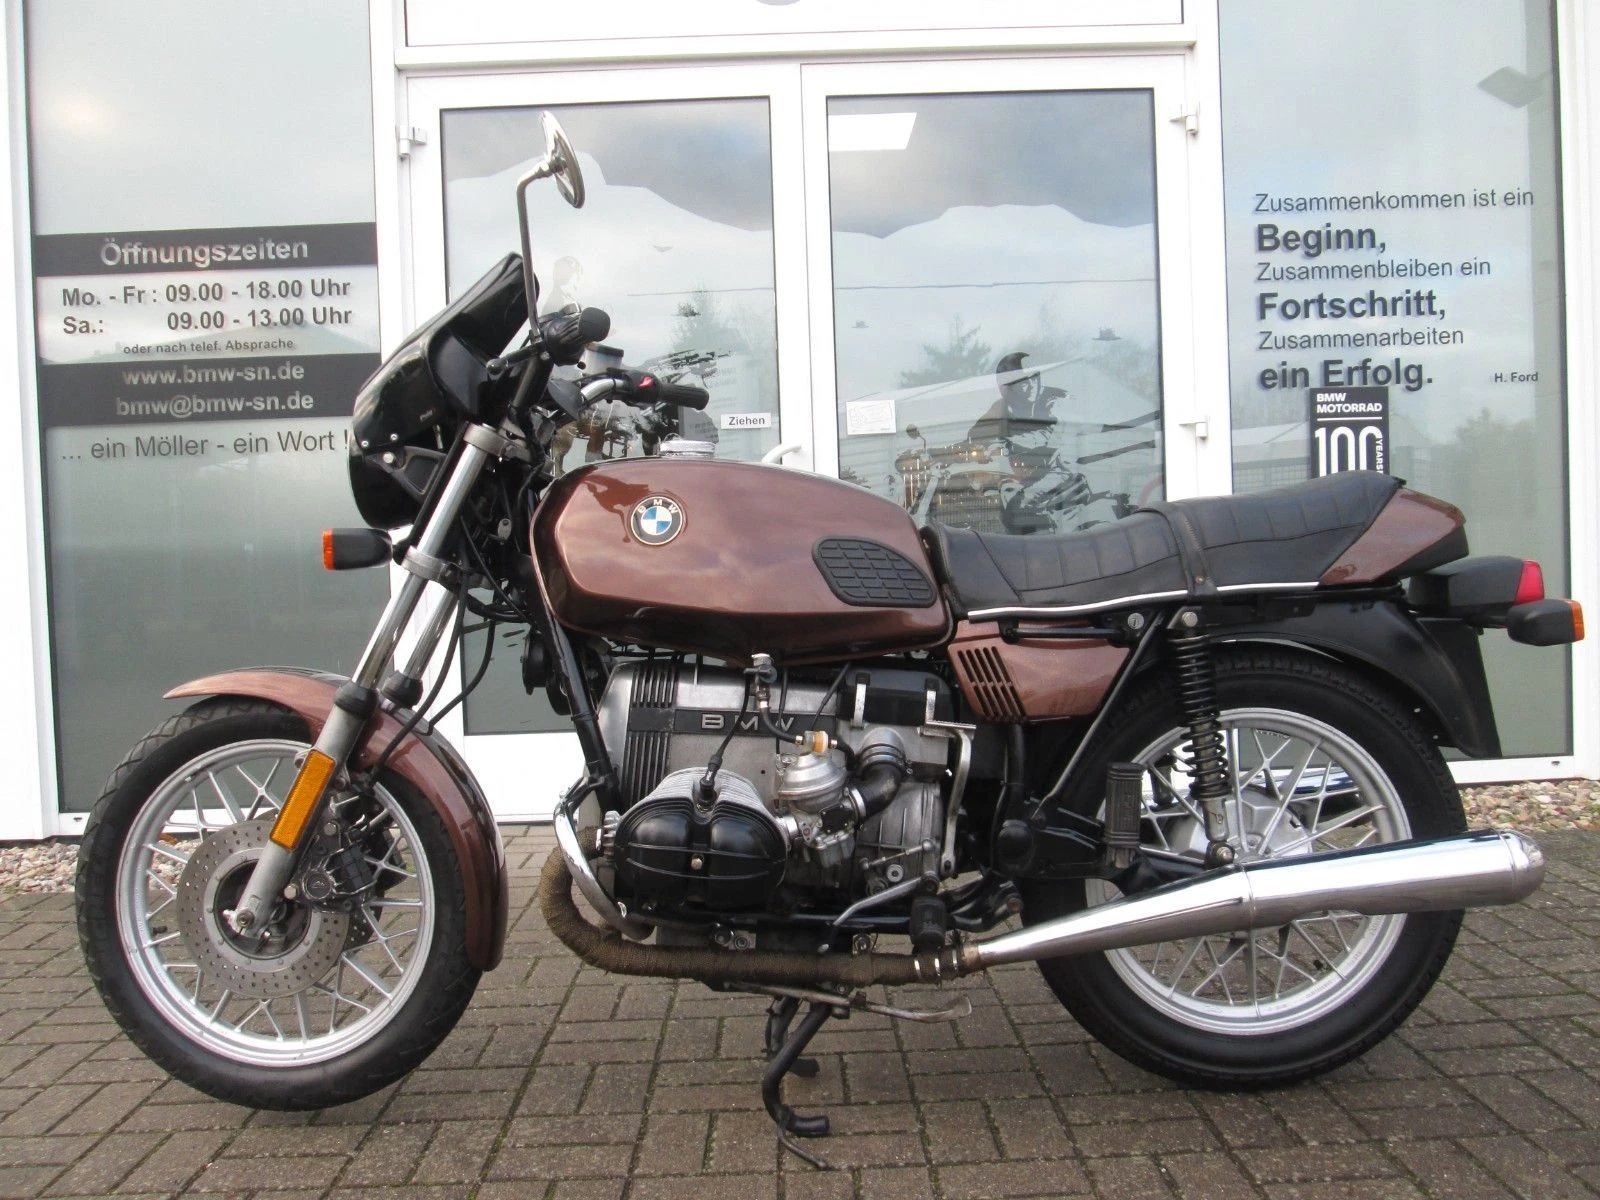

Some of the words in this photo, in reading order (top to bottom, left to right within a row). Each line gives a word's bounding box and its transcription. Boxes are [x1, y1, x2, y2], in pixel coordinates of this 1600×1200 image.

[1254, 191, 1466, 212] Zusammenkommen
[1473, 189, 1496, 207] ist
[1503, 188, 1535, 207] ein
[100, 237, 309, 268] Öffnungszeiten
[1256, 222, 1387, 258] Beginn,
[1256, 259, 1453, 282] Zusammenbleiben
[1460, 257, 1492, 276] ein
[61, 287, 101, 306] Mo.
[165, 282, 223, 303] 09.00
[246, 279, 303, 299] 18.00
[311, 278, 351, 297] Uhr
[1257, 289, 1446, 321] Fortschritt,
[63, 316, 104, 335] Sa.:
[167, 311, 225, 331] 09.00
[247, 307, 304, 327] 13.00
[312, 306, 353, 326] Uhr
[123, 343, 154, 354] oder
[156, 341, 187, 353] nach
[190, 340, 222, 352] telef.
[225, 338, 294, 352] Absprache
[1258, 327, 1464, 351] Zusammenarbeiten
[121, 360, 305, 386] www.bmw-sn.de
[1259, 360, 1310, 389] ein
[1322, 357, 1434, 393] Erfolg.
[1493, 372, 1509, 384] H.
[1510, 371, 1539, 383] Ford
[115, 390, 314, 419] bmw@bmw-sn.de
[1316, 392, 1347, 402] BMW
[1316, 402, 1383, 414] MOTORRAD
[728, 416, 766, 426] Ziehen
[91, 437, 126, 459] ein
[135, 434, 209, 458] Möller
[233, 432, 269, 454] ein
[277, 430, 335, 452] Wort
[1314, 425, 1384, 478] 100
[1375, 438, 1384, 470] YEARS
[637, 498, 679, 514] BMW
